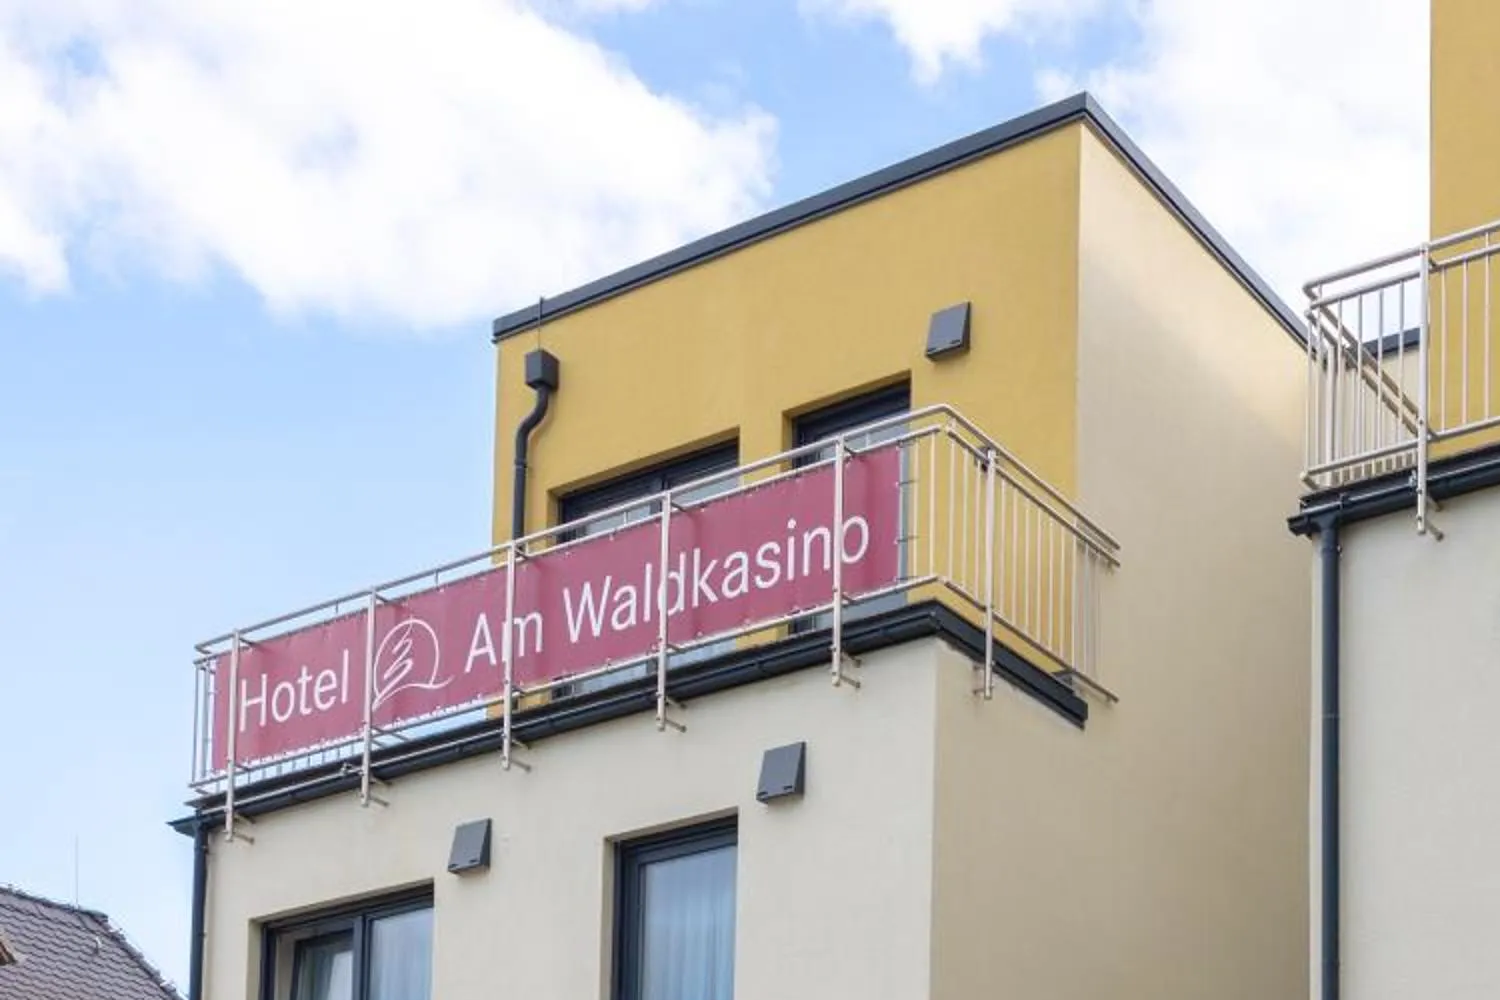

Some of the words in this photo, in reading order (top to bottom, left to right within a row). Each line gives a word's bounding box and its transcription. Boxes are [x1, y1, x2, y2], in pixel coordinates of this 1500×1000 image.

[238, 648, 349, 733] Hotel
[464, 610, 543, 673] Am
[562, 514, 870, 644] Waldkasino
